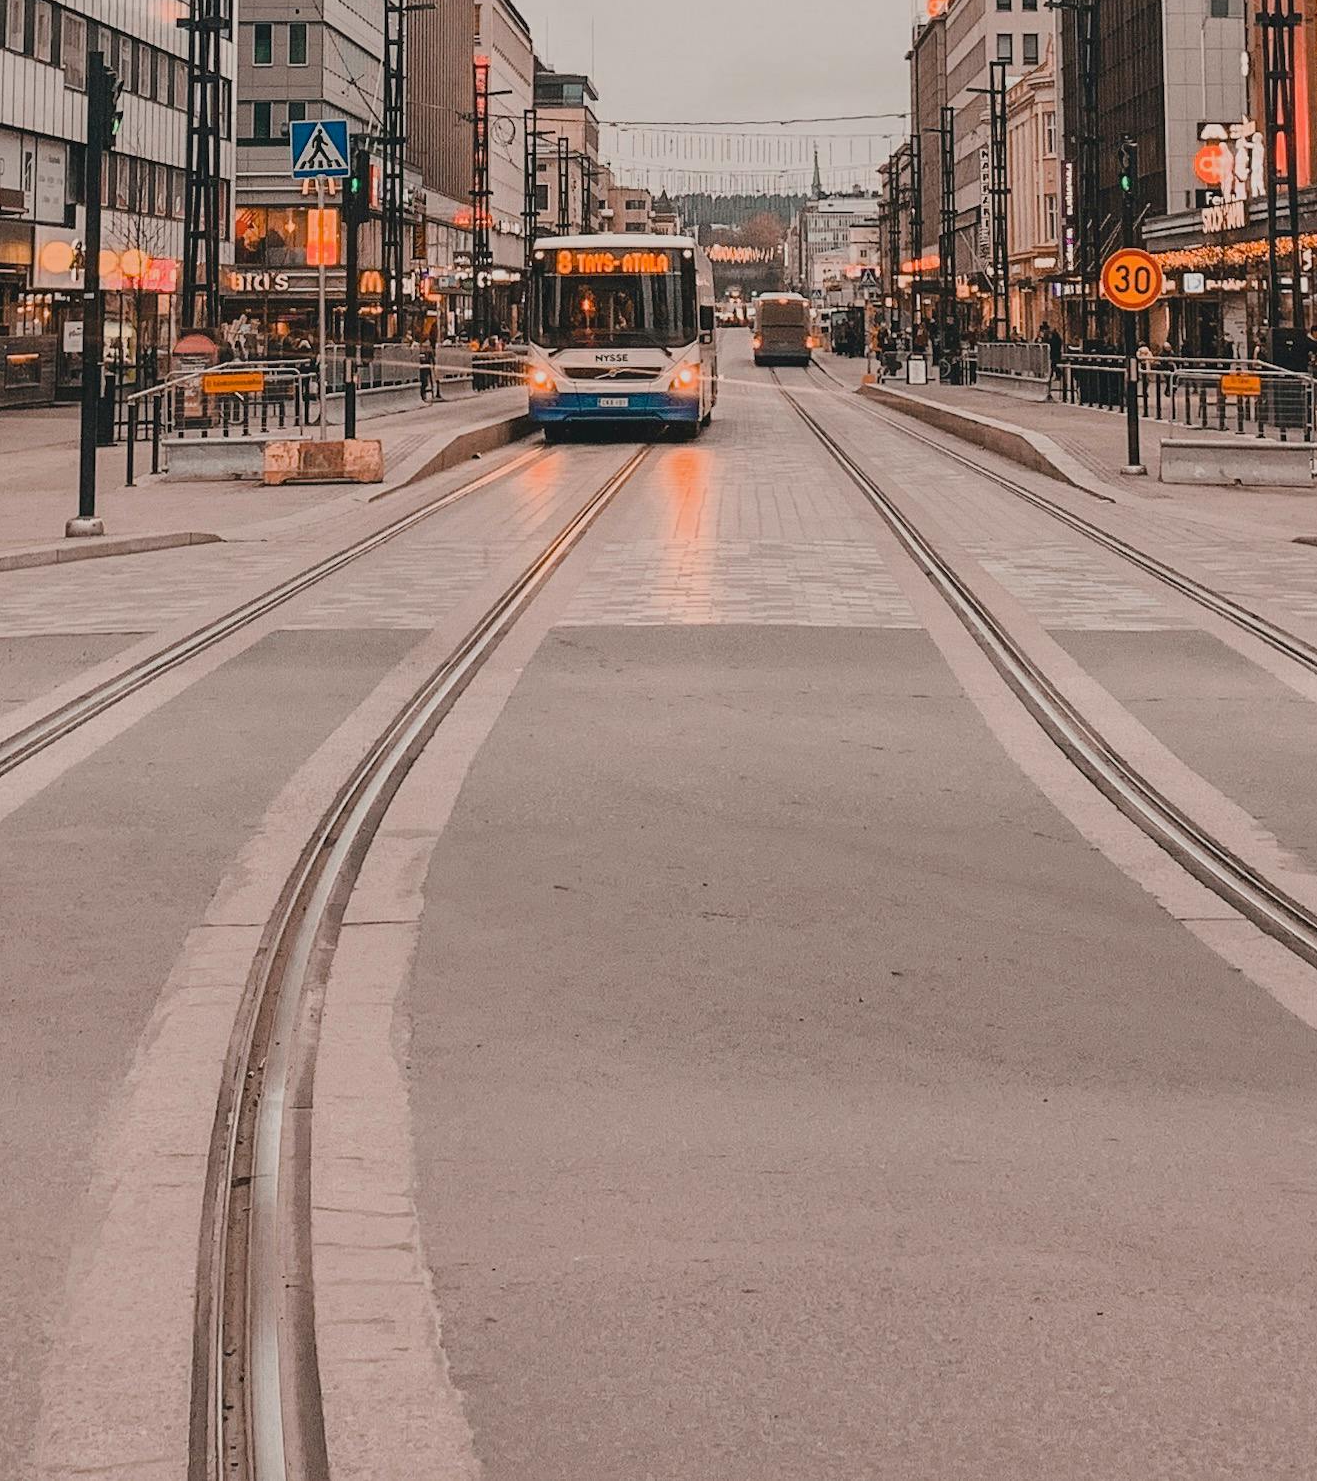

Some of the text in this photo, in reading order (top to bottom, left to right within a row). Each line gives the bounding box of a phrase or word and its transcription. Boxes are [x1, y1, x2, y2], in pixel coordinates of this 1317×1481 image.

[557, 250, 669, 274] 8 TAYS-ATALA
[1114, 265, 1151, 295] 30
[595, 354, 629, 362] NYSSE
